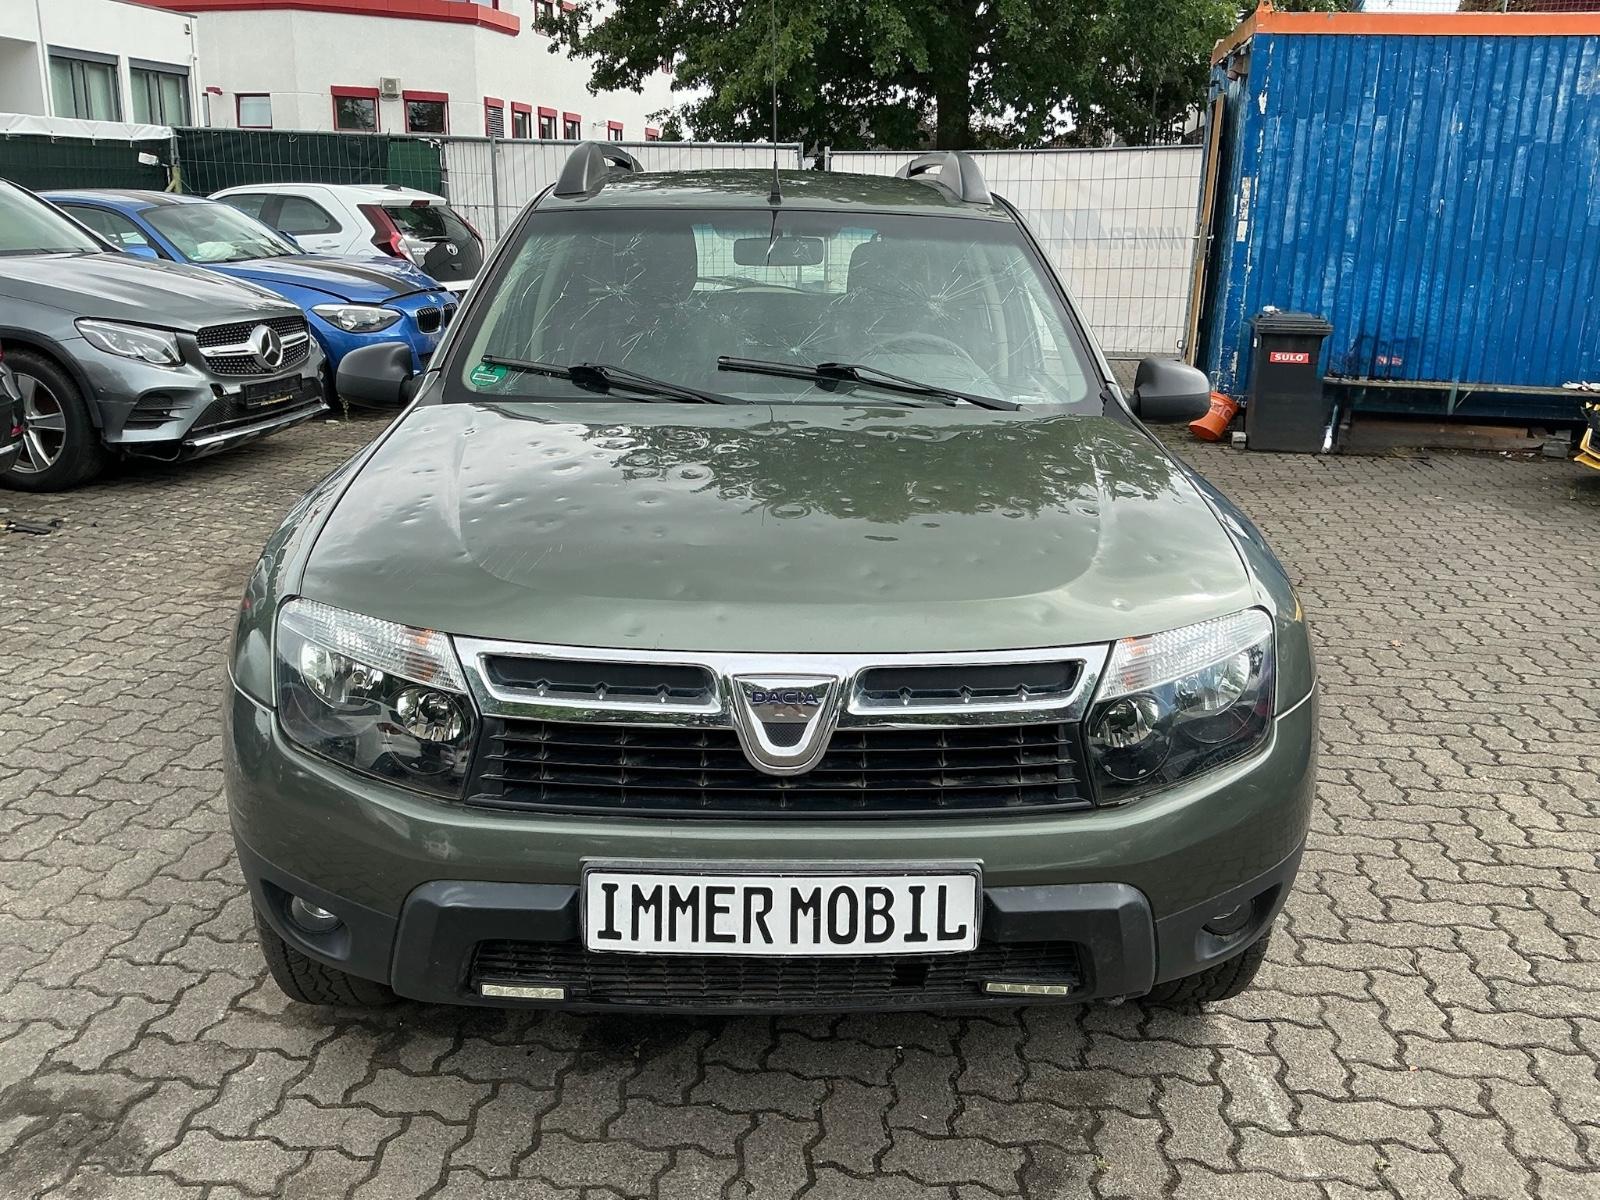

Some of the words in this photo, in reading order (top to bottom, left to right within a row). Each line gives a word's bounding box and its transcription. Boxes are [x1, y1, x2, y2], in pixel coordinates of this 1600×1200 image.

[1274, 353, 1304, 362] SULO
[752, 691, 818, 705] DACIA
[597, 883, 773, 944] IMMER
[790, 885, 967, 944] MOBIL
